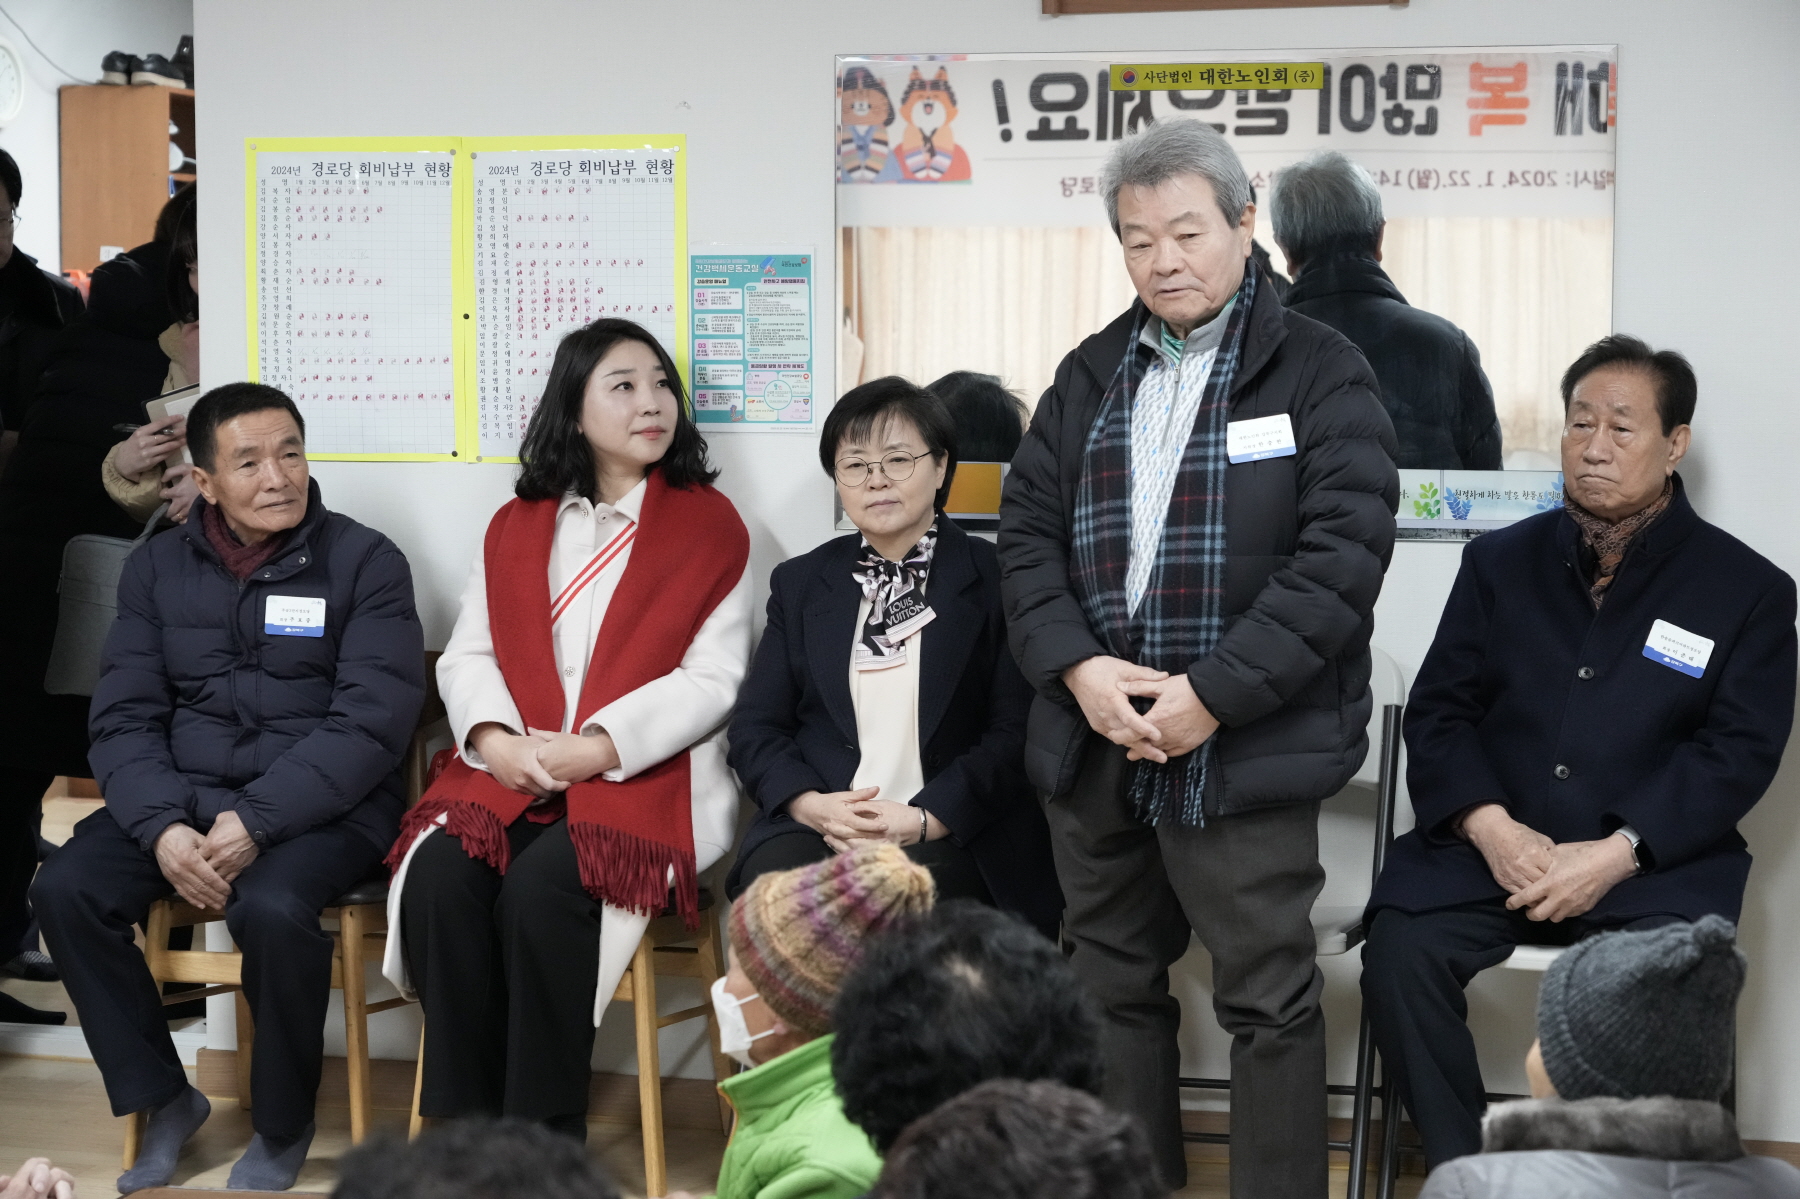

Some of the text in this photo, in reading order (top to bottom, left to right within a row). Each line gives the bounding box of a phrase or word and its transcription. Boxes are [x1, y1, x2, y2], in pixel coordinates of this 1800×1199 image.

[1143, 67, 1315, 85] 사단법인 대한노인회 (증)
[271, 161, 453, 177] 2024년 경로당 회비납부 현황
[488, 159, 675, 177] 2024년 경로당 회비납부 현황
[695, 264, 759, 273] 건강백세운동교실
[1454, 489, 1485, 500] 친절하게
[1487, 489, 1502, 500] 하는
[886, 602, 926, 626] VUITTON
[889, 597, 914, 615] LOUIS
